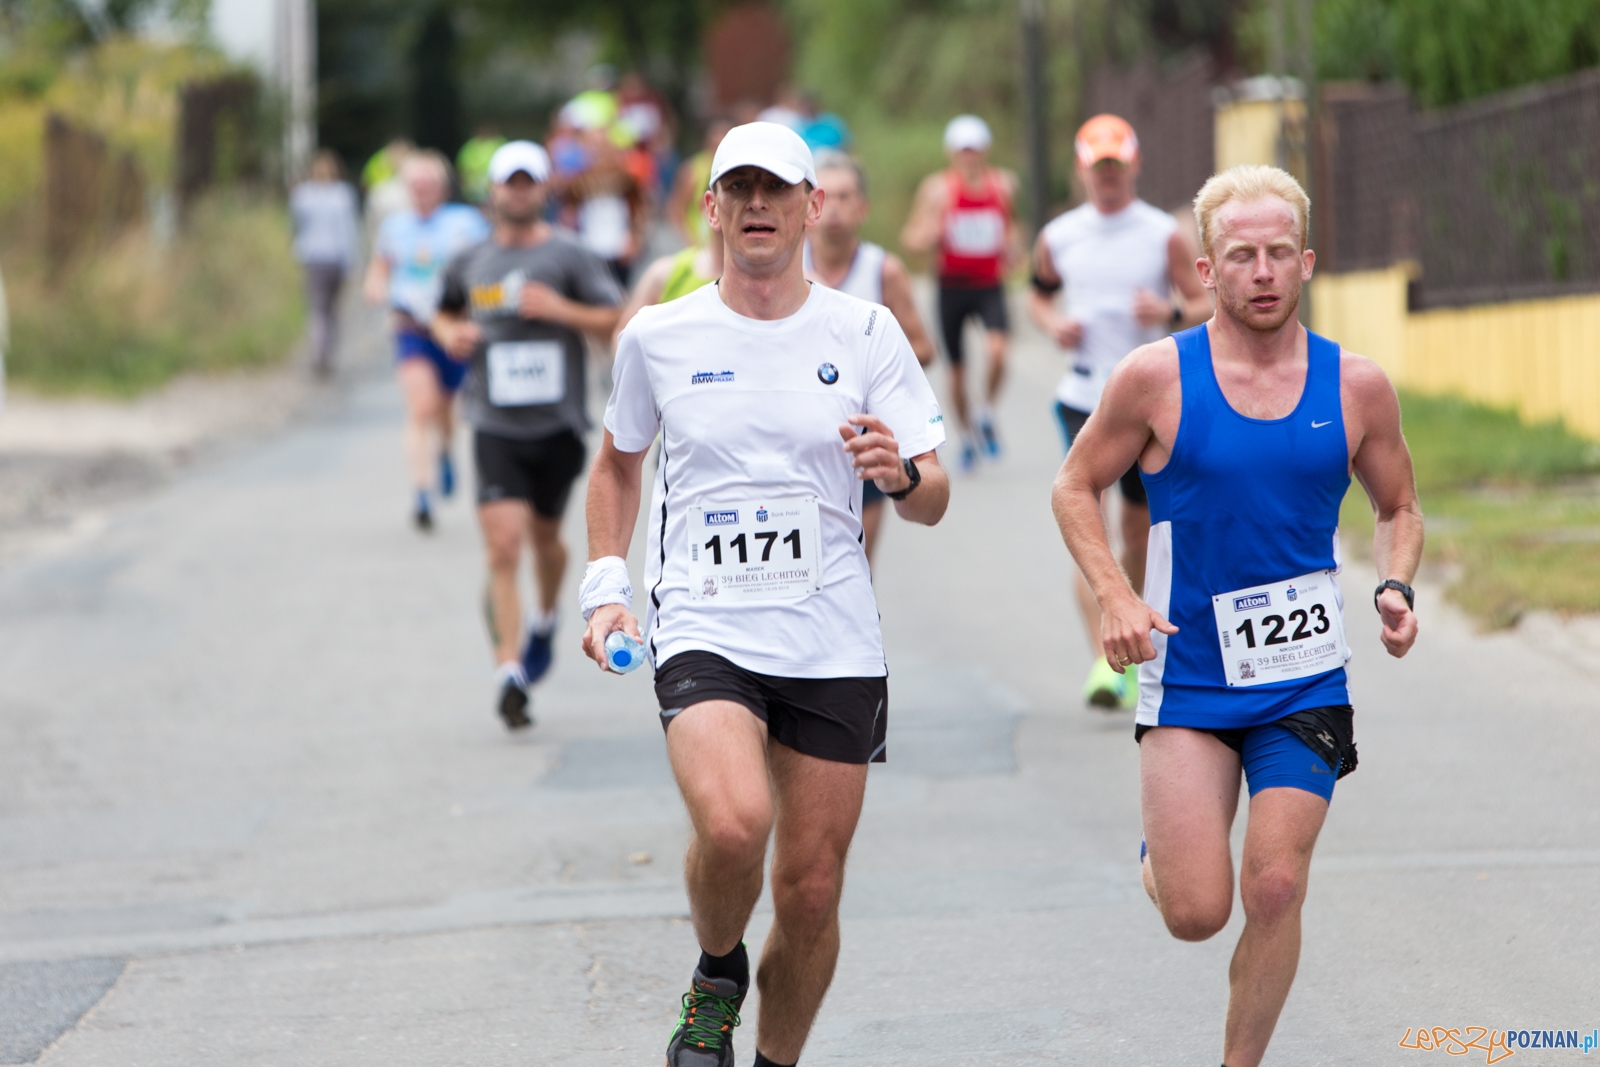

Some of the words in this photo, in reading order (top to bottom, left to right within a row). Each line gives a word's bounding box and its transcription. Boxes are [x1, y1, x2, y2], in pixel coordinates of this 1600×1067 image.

[864, 309, 877, 336] Reebok
[705, 528, 802, 565] 1171
[721, 575, 733, 584] 39
[735, 573, 758, 583] BIEG
[1236, 603, 1330, 649] 1223
[1279, 644, 1304, 652] NIKODEM
[1257, 657, 1269, 666] 39
[1272, 653, 1296, 664] BIEG
